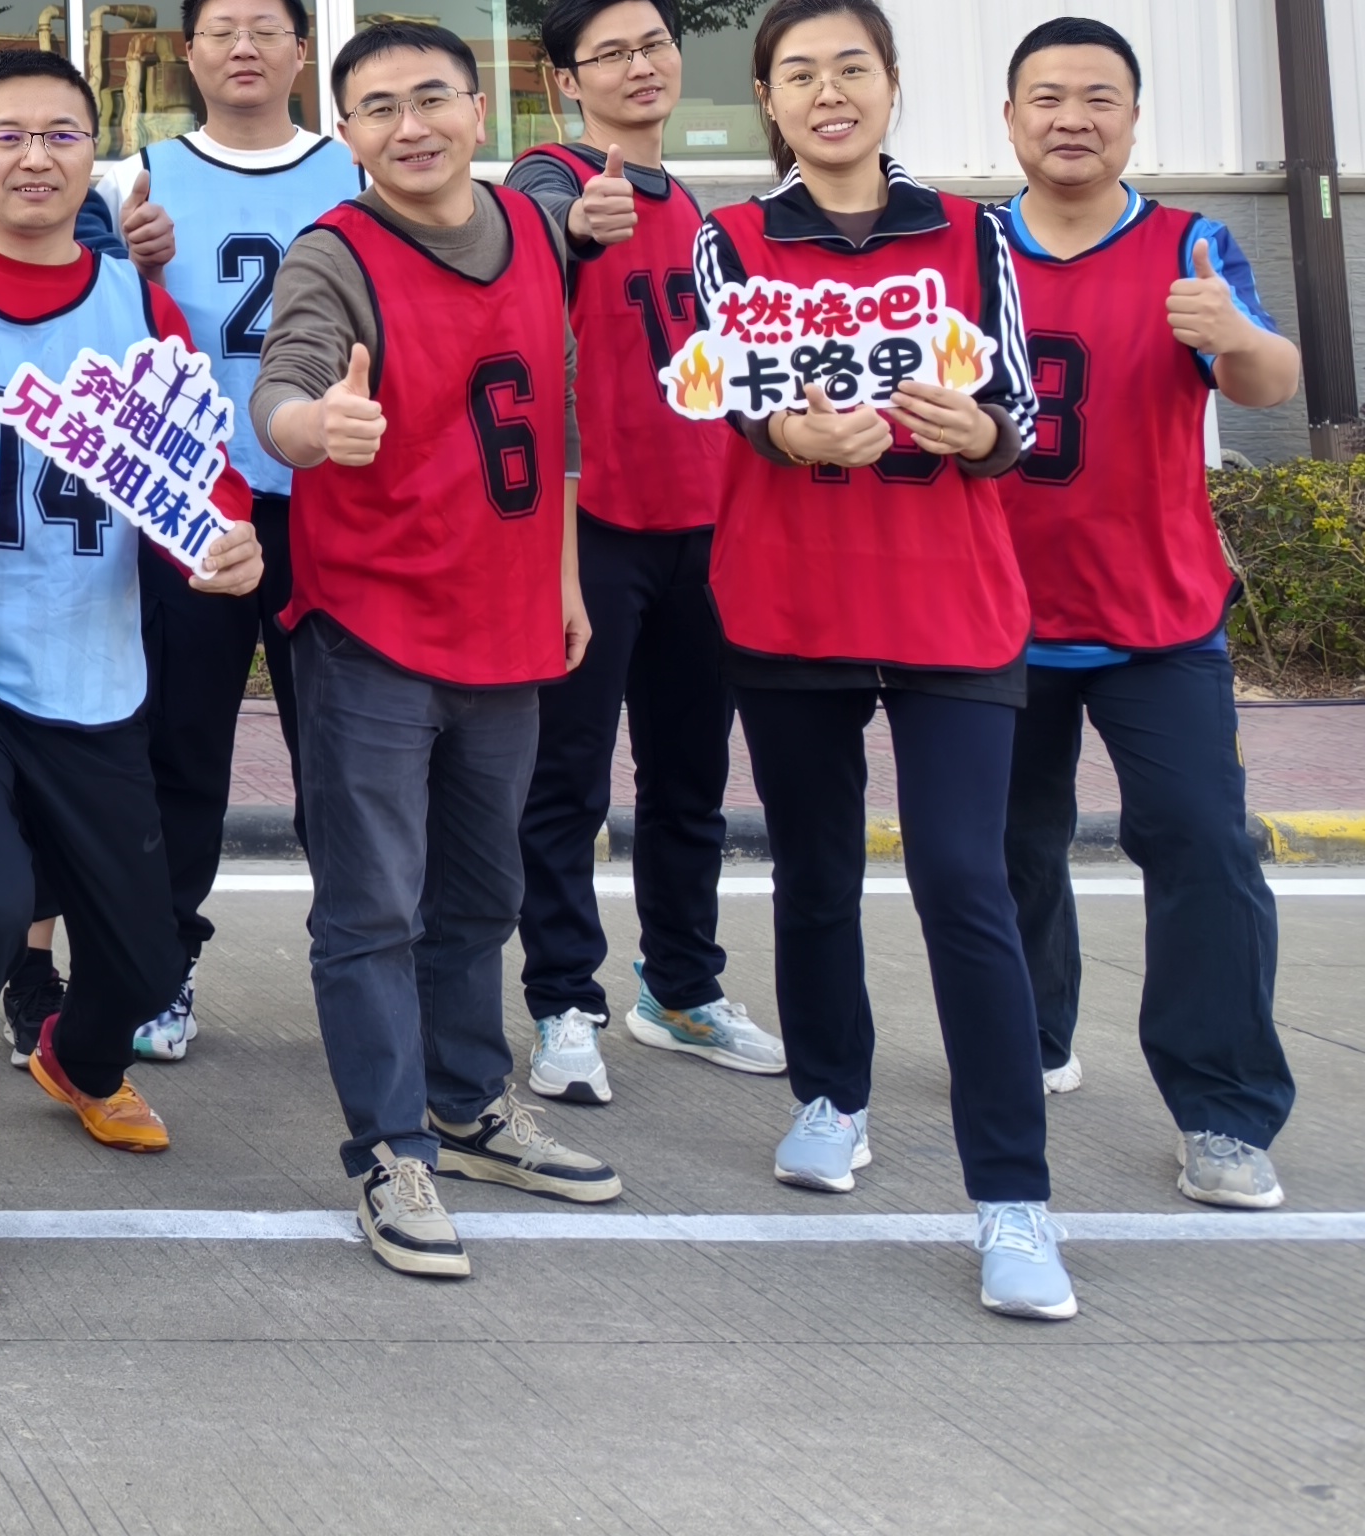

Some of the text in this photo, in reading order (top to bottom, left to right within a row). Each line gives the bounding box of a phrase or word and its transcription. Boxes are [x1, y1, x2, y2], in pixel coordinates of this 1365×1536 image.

[217, 233, 285, 358] 2
[466, 350, 542, 520] 6
[729, 337, 923, 411] 卡路里
[3, 374, 228, 560] 兄弟姐妹们
